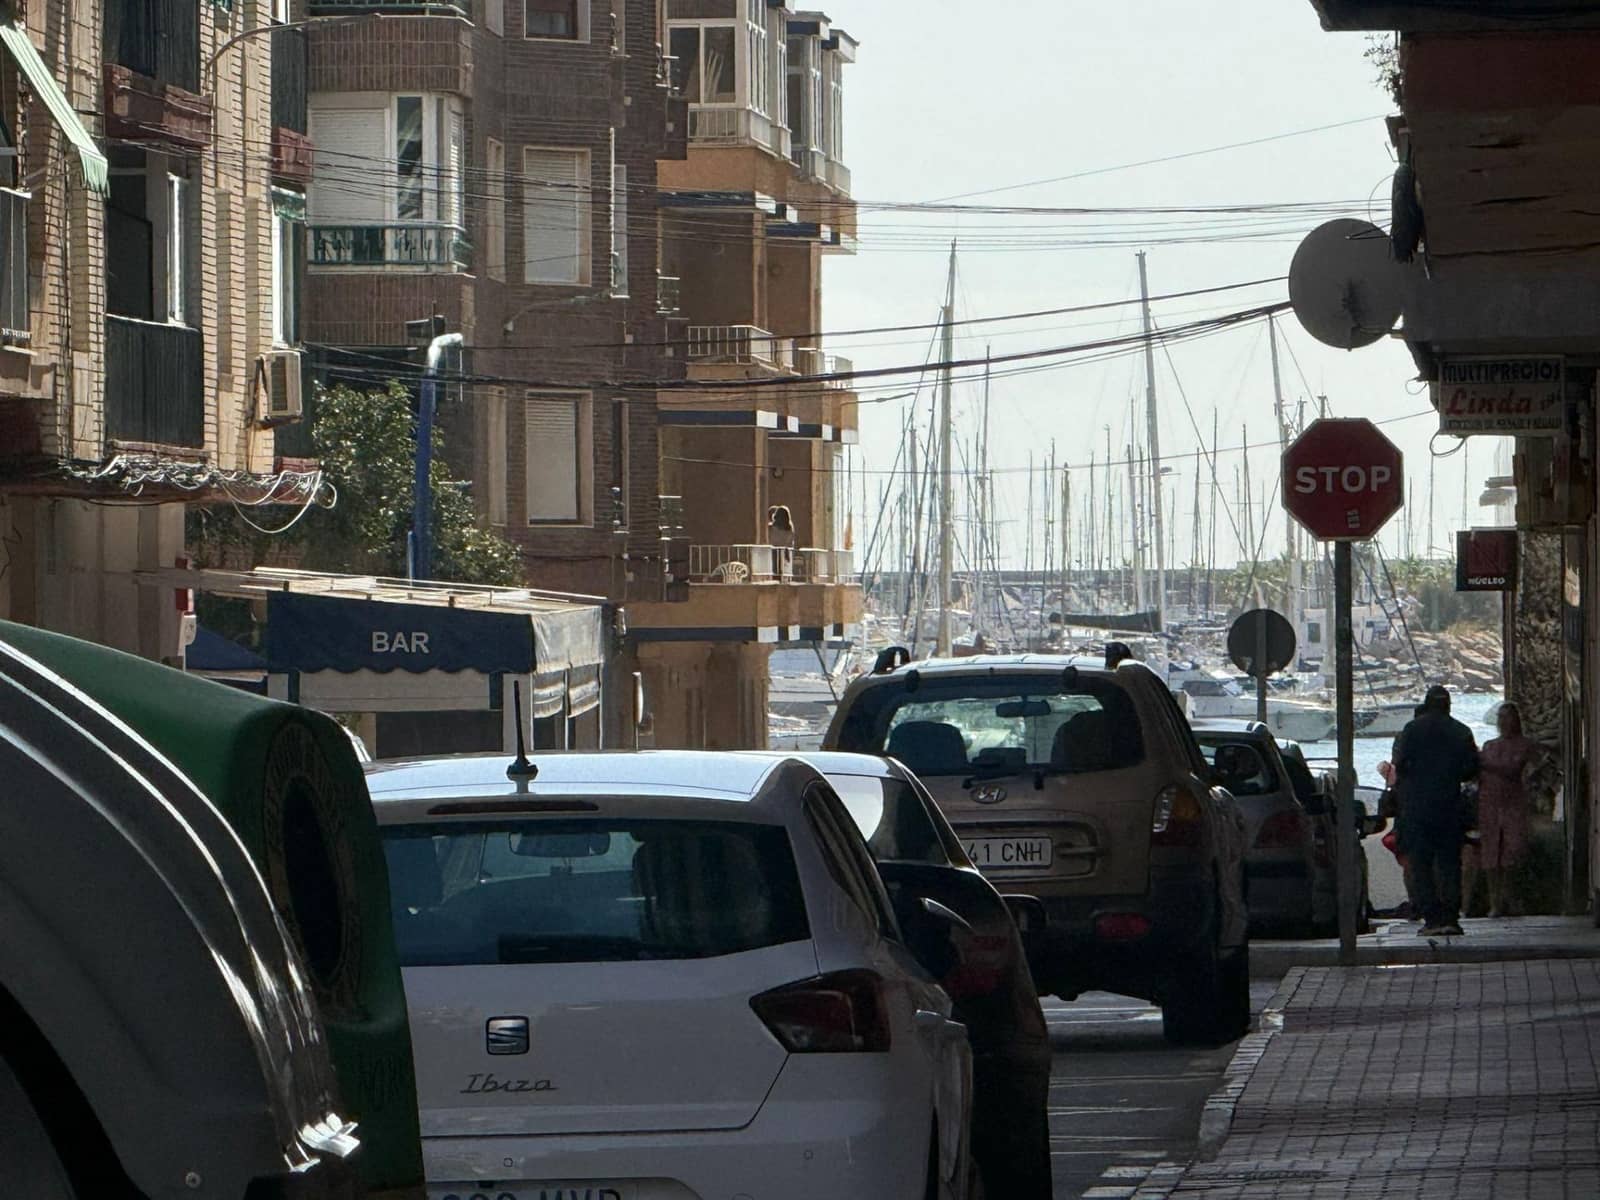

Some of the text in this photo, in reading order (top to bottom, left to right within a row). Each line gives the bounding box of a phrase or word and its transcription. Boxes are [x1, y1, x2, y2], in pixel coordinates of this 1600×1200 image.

[1445, 387, 1531, 416] Linda
[1295, 465, 1391, 494] STOP
[372, 631, 430, 654] BAR
[1002, 842, 1042, 862] CNH
[460, 1073, 559, 1094] Ibiza
